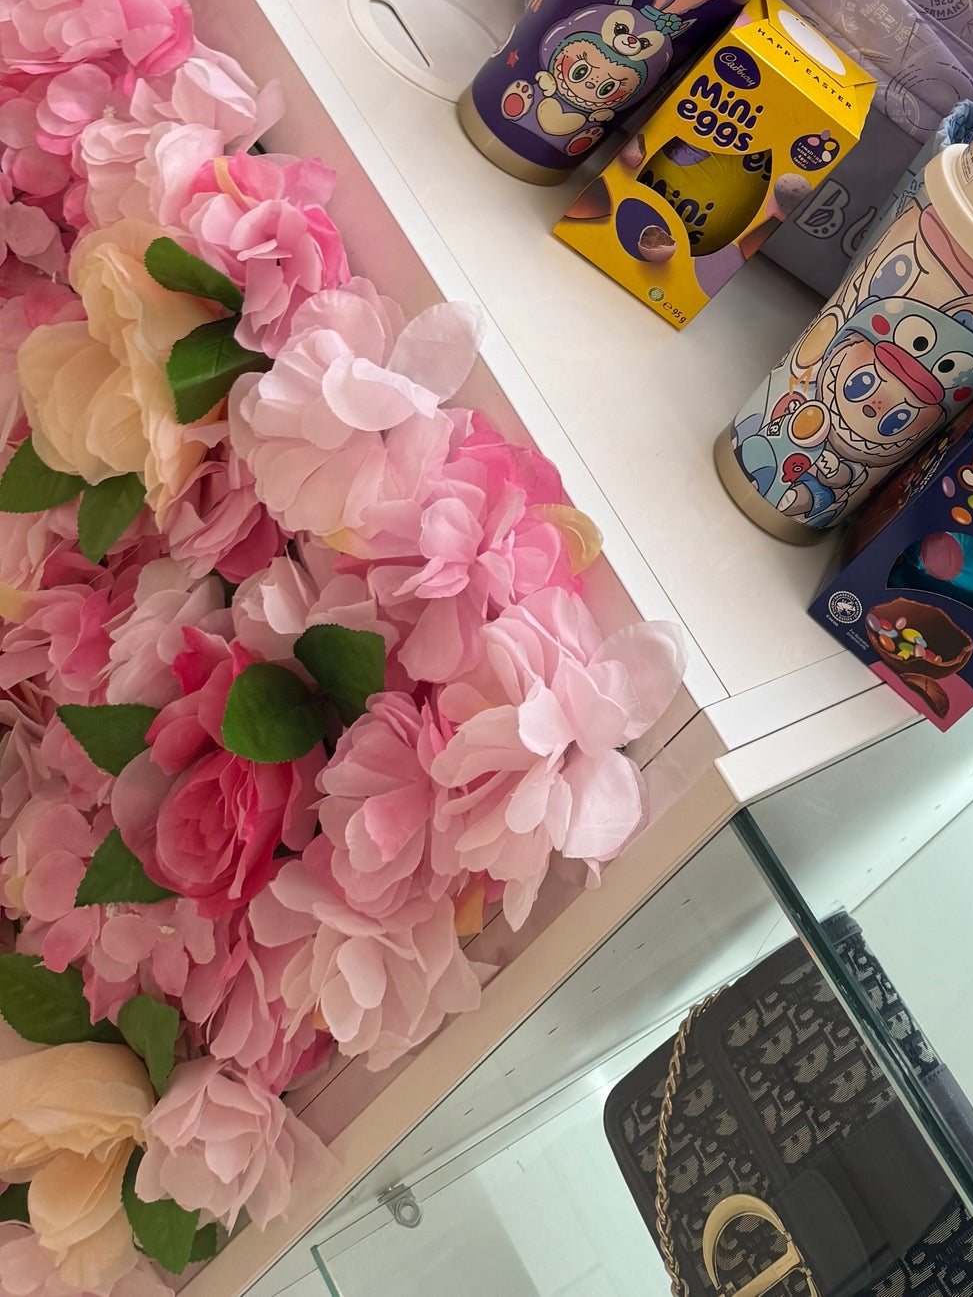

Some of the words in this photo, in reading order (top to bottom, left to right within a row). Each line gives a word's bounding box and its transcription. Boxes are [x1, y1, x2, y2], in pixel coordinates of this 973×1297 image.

[718, 53, 757, 87] Cadbury
[757, 27, 800, 64] HAPPY
[805, 67, 853, 110] EASTER
[676, 98, 753, 152] eggs
[689, 74, 764, 130] Mini
